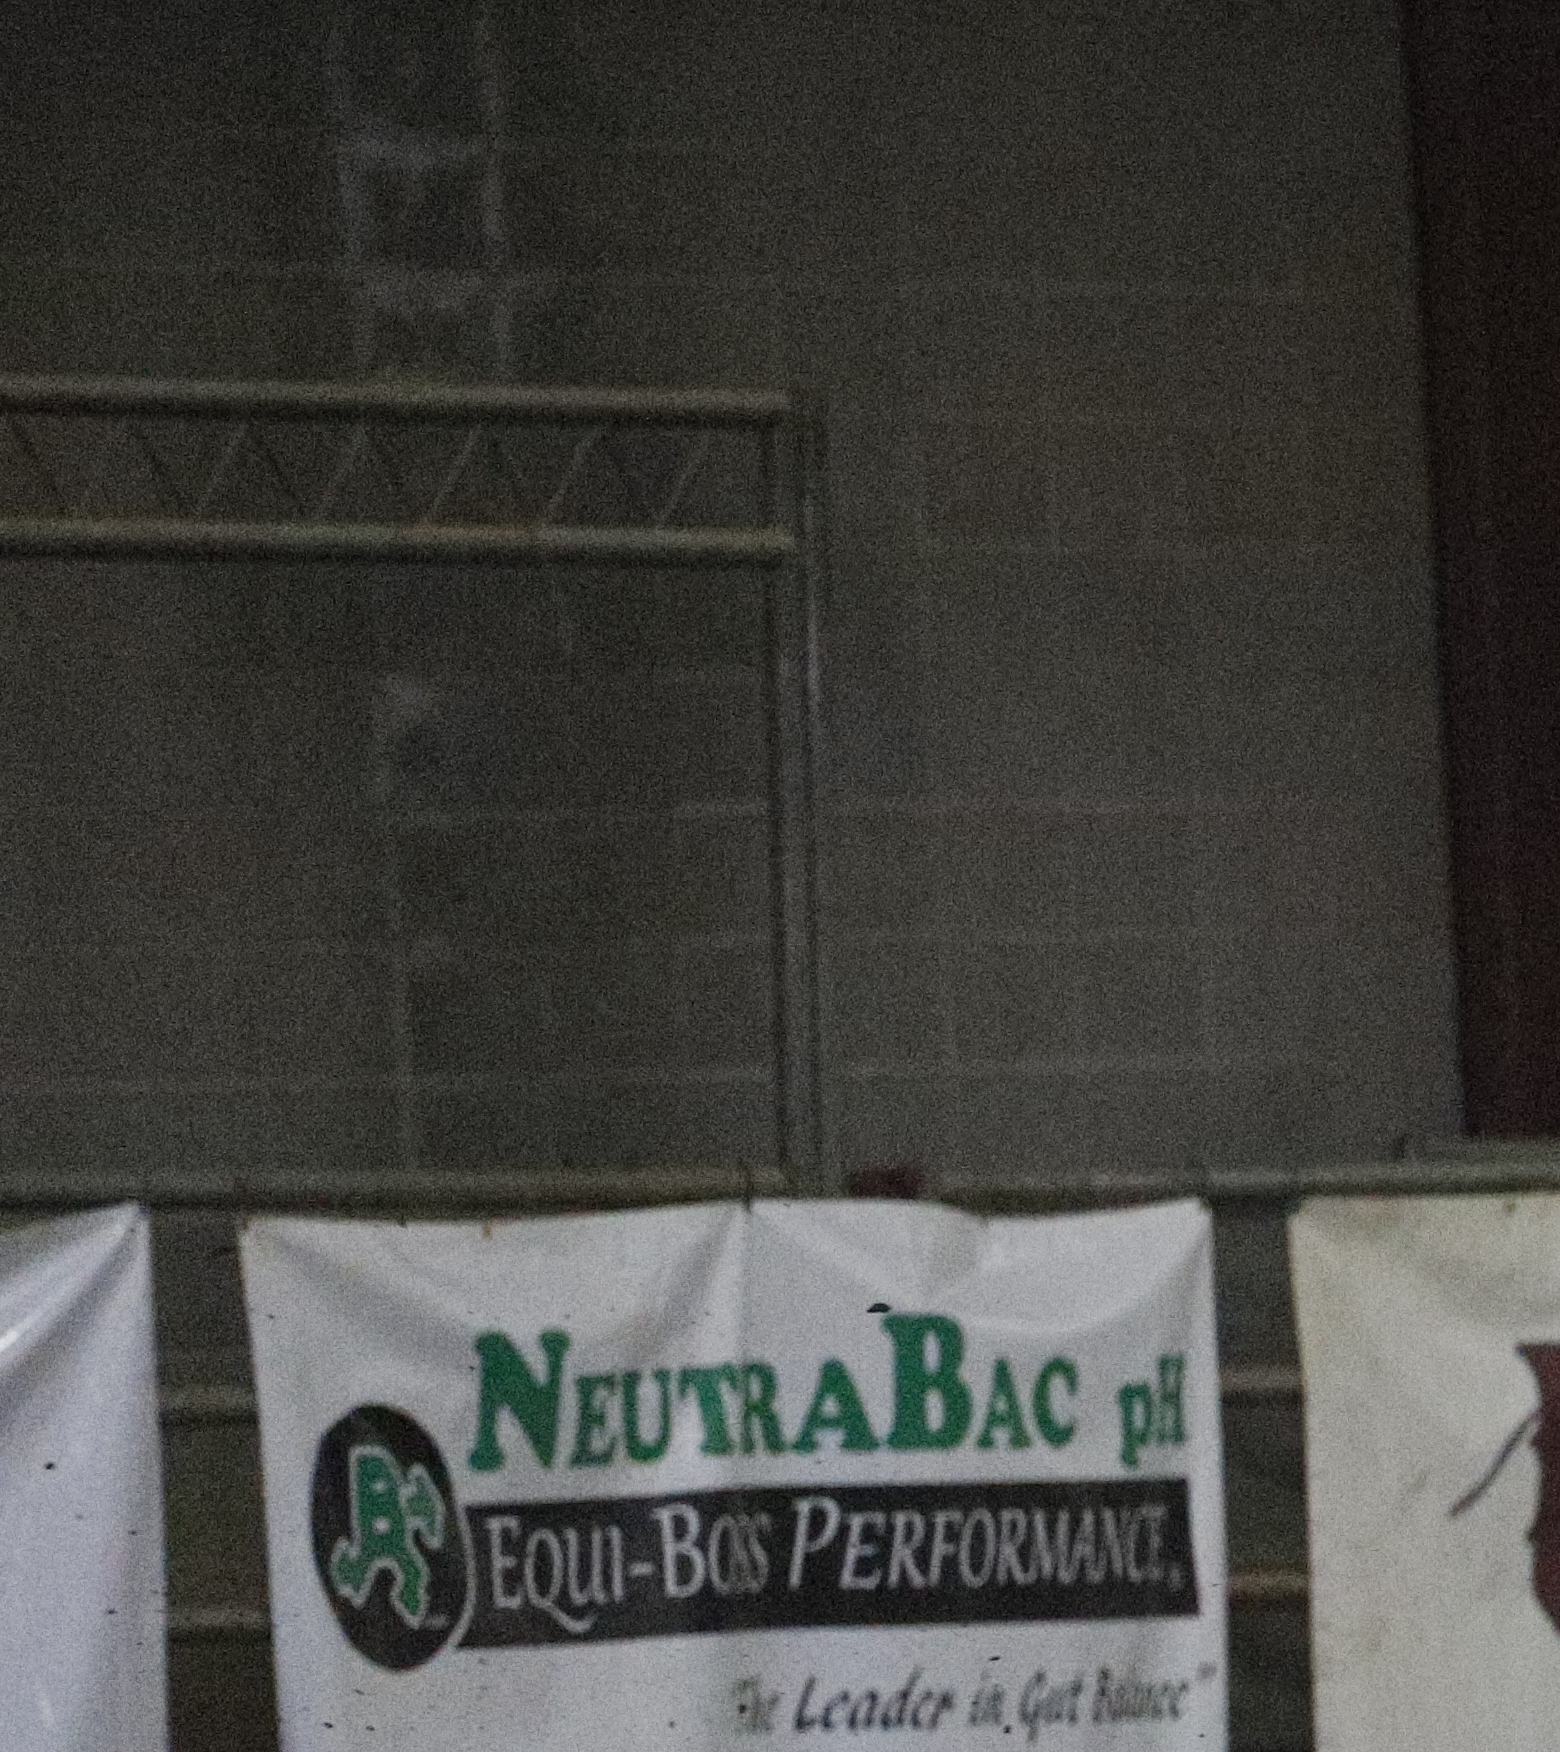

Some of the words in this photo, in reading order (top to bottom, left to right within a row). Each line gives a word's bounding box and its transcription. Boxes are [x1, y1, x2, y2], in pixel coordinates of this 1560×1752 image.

[1121, 1356, 1185, 1464] pH
[794, 1668, 953, 1732] Leader
[970, 1672, 1002, 1728] in
